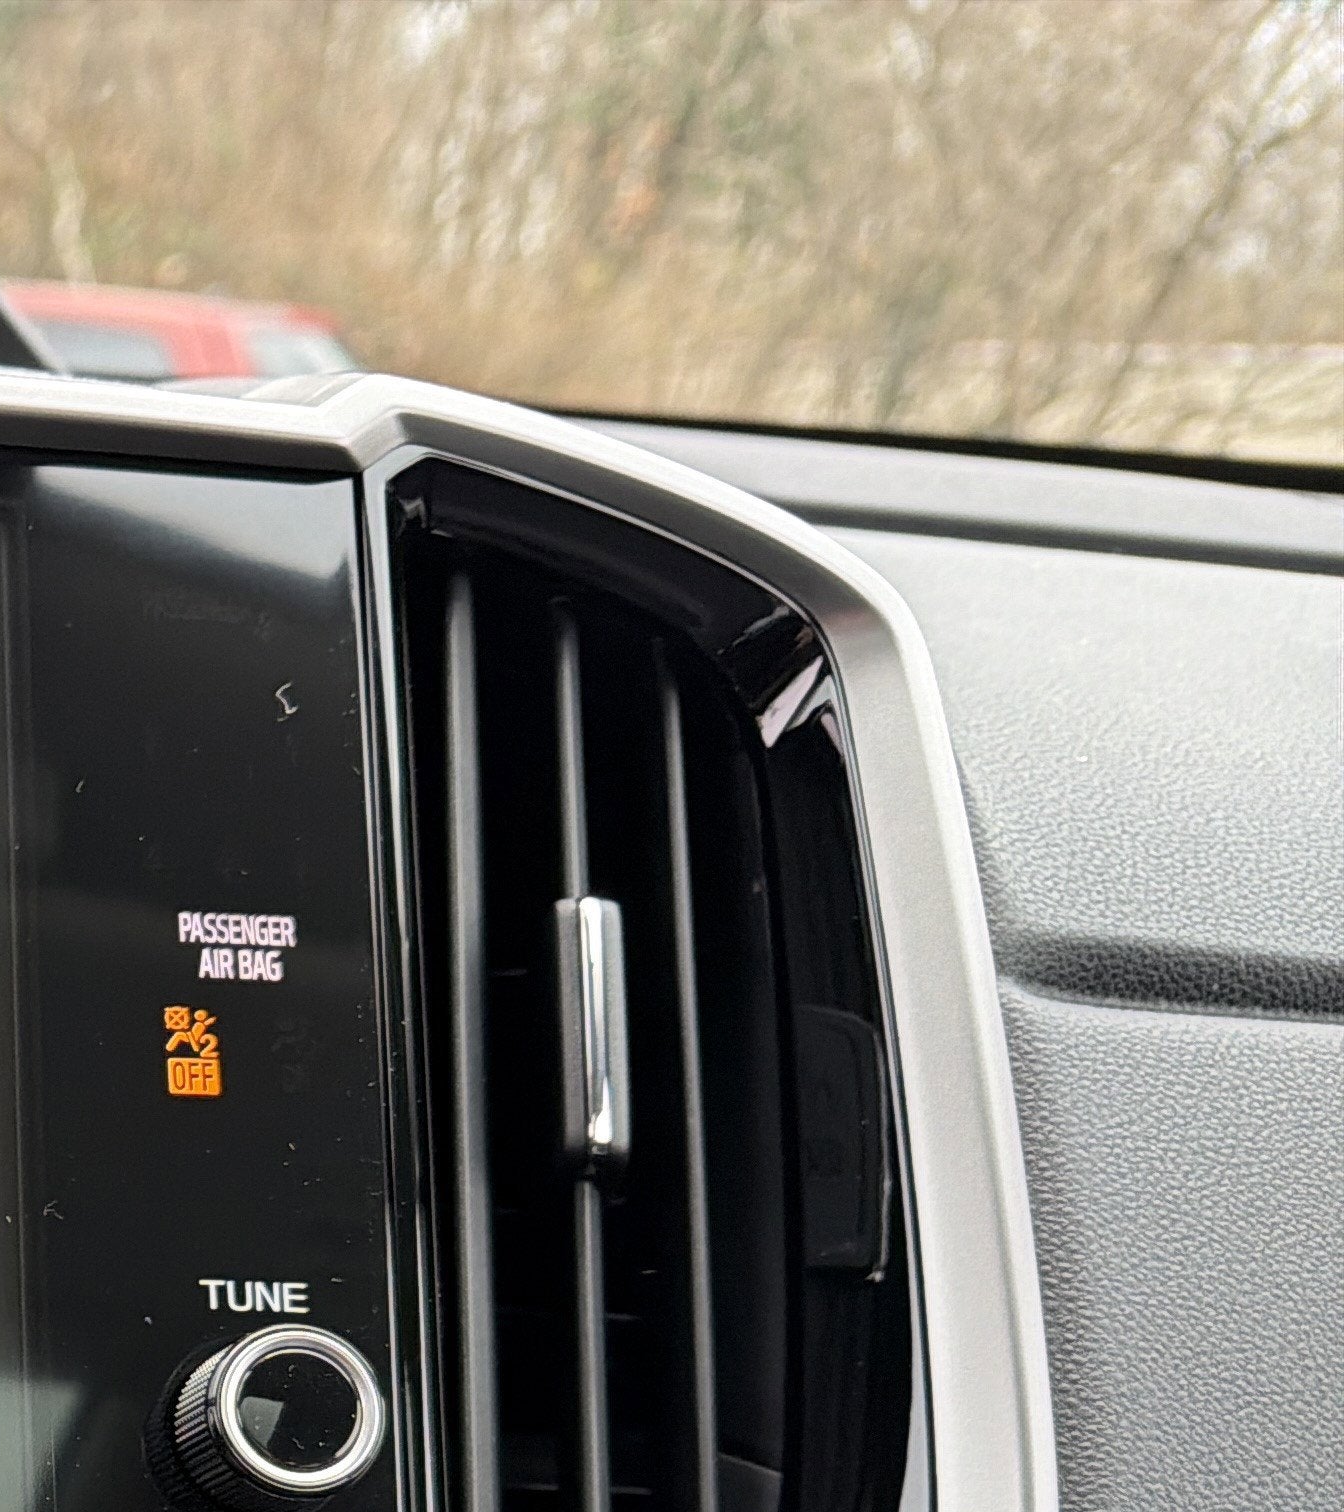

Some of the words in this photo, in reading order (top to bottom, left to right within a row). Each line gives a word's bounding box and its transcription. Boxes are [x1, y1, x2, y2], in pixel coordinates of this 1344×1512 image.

[177, 911, 297, 948] PASSENGER
[198, 947, 235, 980] AIR
[237, 949, 285, 982] BAG
[171, 1060, 216, 1092] OFF
[198, 1279, 310, 1314] TUNE
